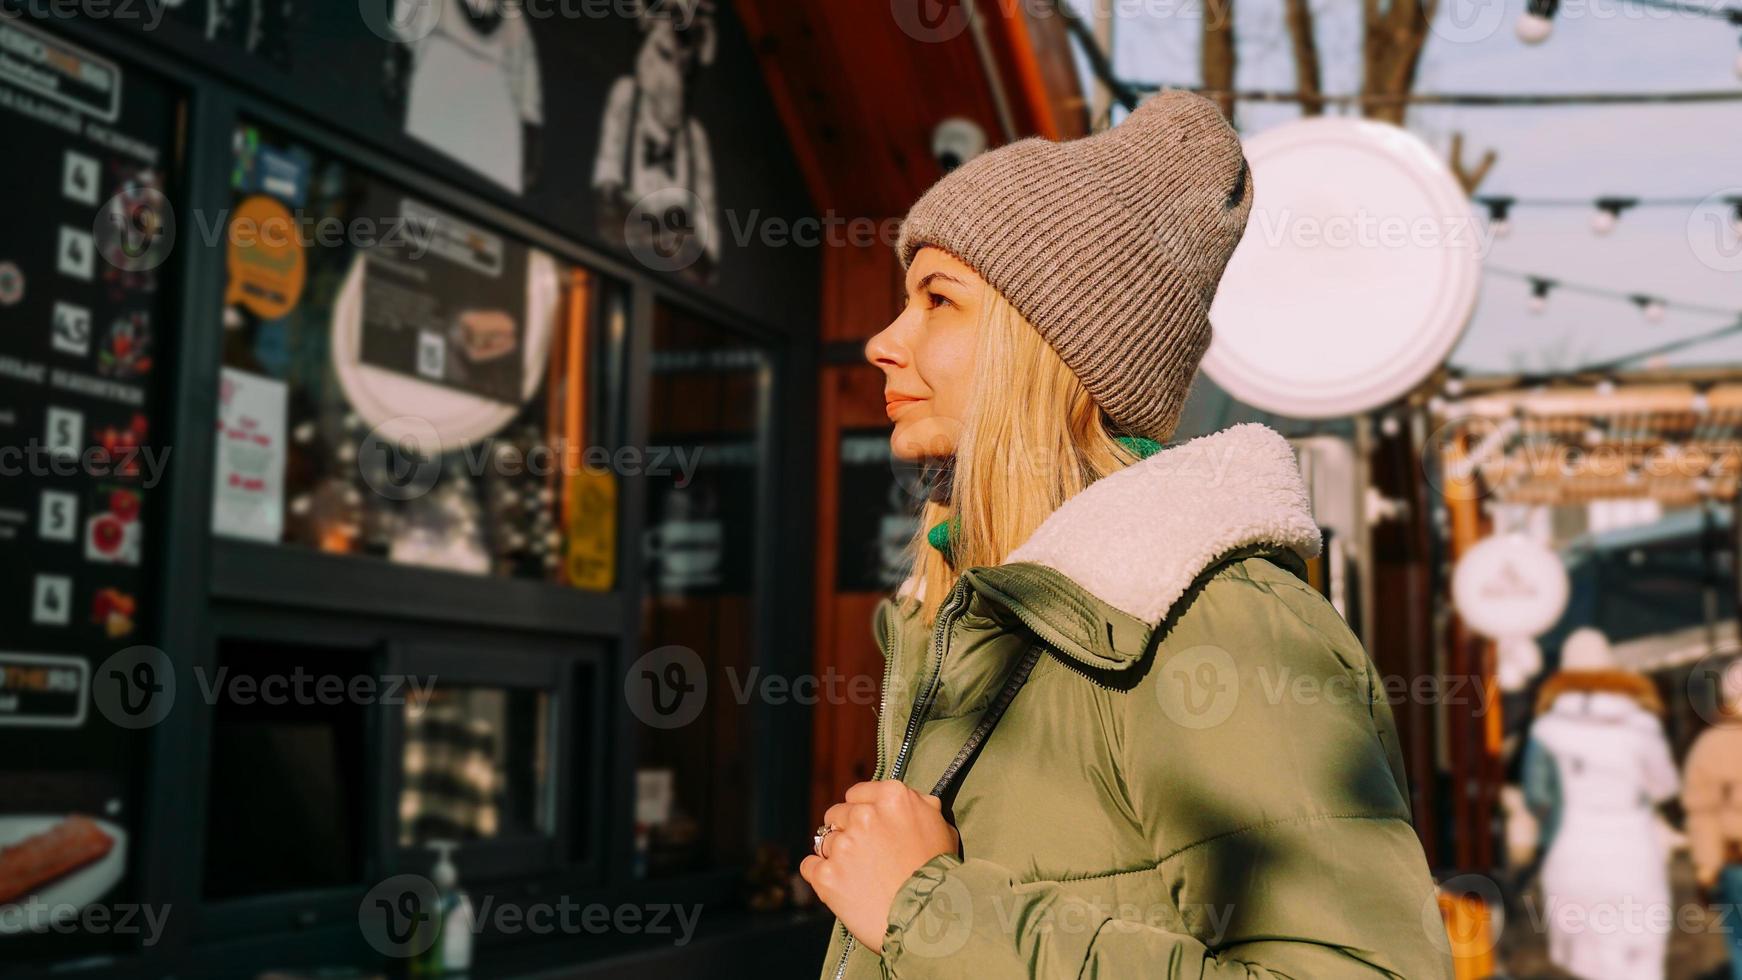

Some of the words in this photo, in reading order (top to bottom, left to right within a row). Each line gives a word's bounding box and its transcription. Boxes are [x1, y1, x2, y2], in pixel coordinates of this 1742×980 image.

[58, 418, 71, 447] 5
[51, 500, 65, 530] 5
[43, 584, 60, 612] 4
